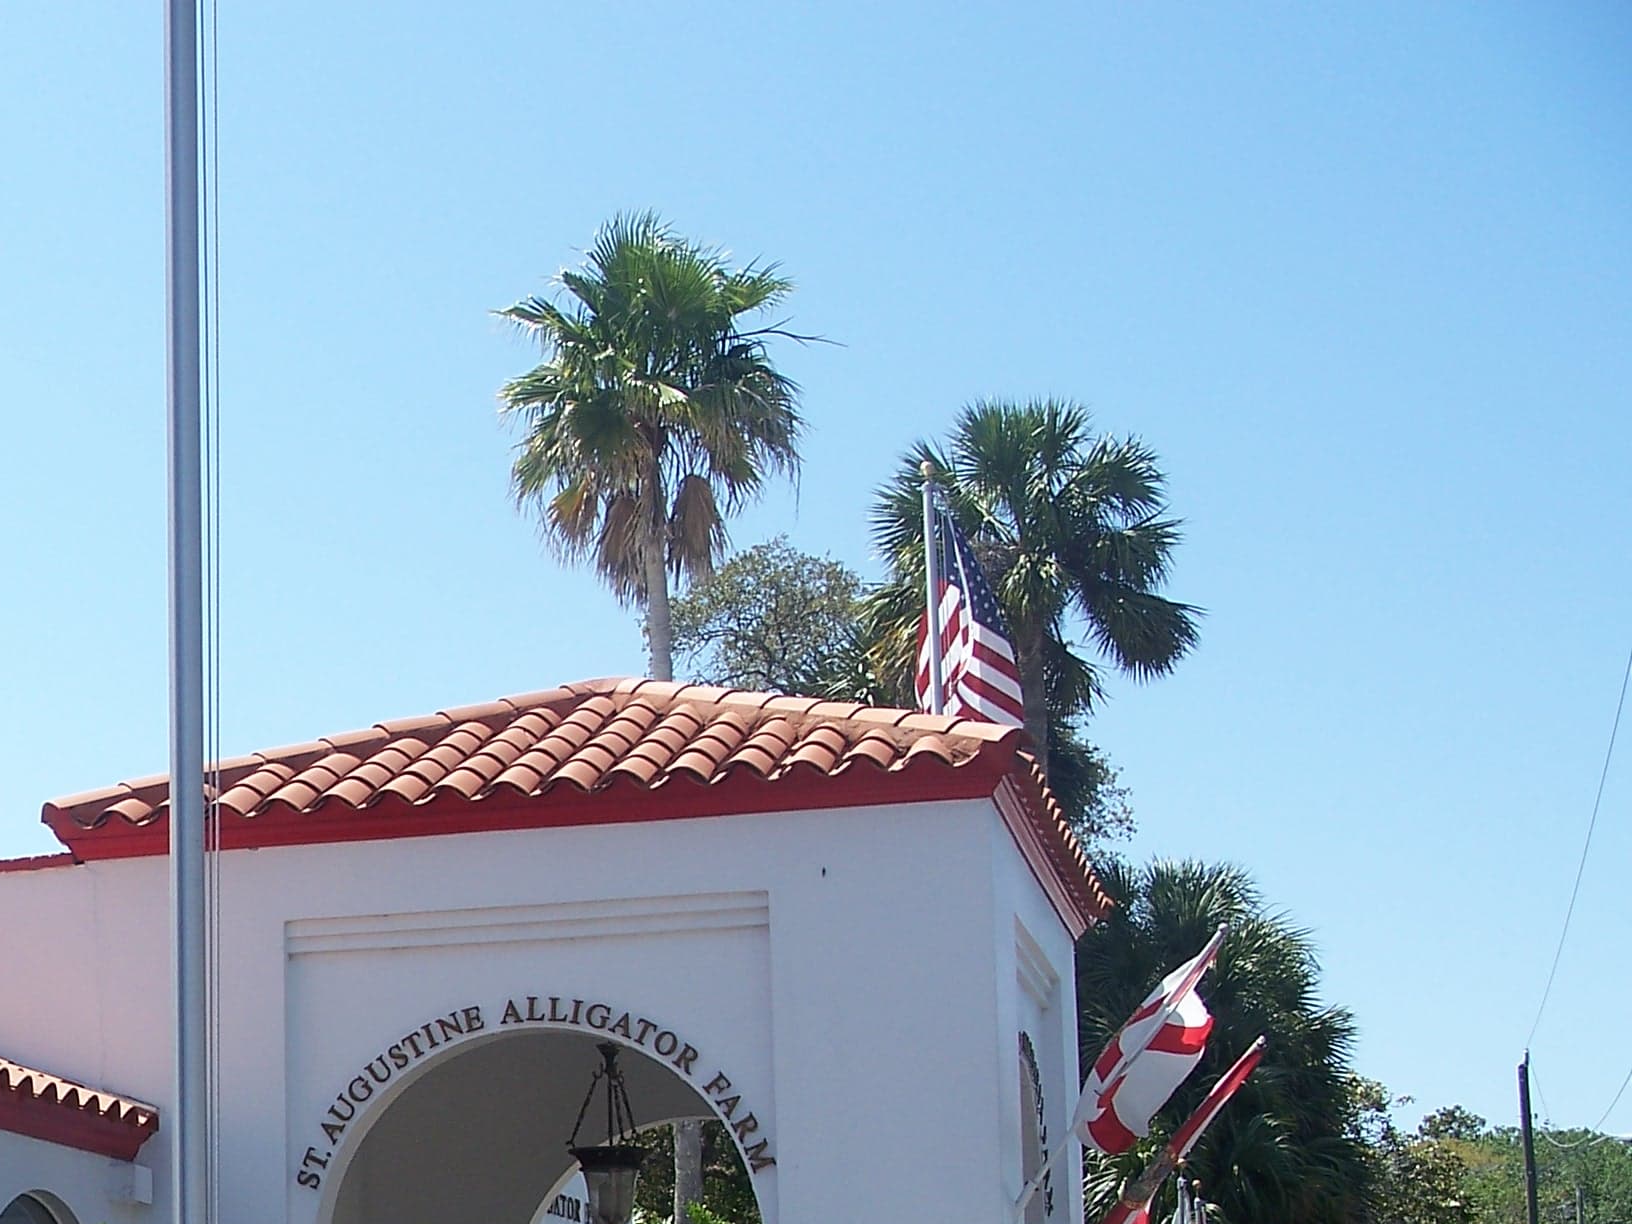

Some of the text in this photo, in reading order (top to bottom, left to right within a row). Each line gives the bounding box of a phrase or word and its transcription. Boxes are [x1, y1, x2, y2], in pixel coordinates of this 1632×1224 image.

[297, 996, 776, 1190] ST. AUGUSTINE ALLIGATOR FARM
